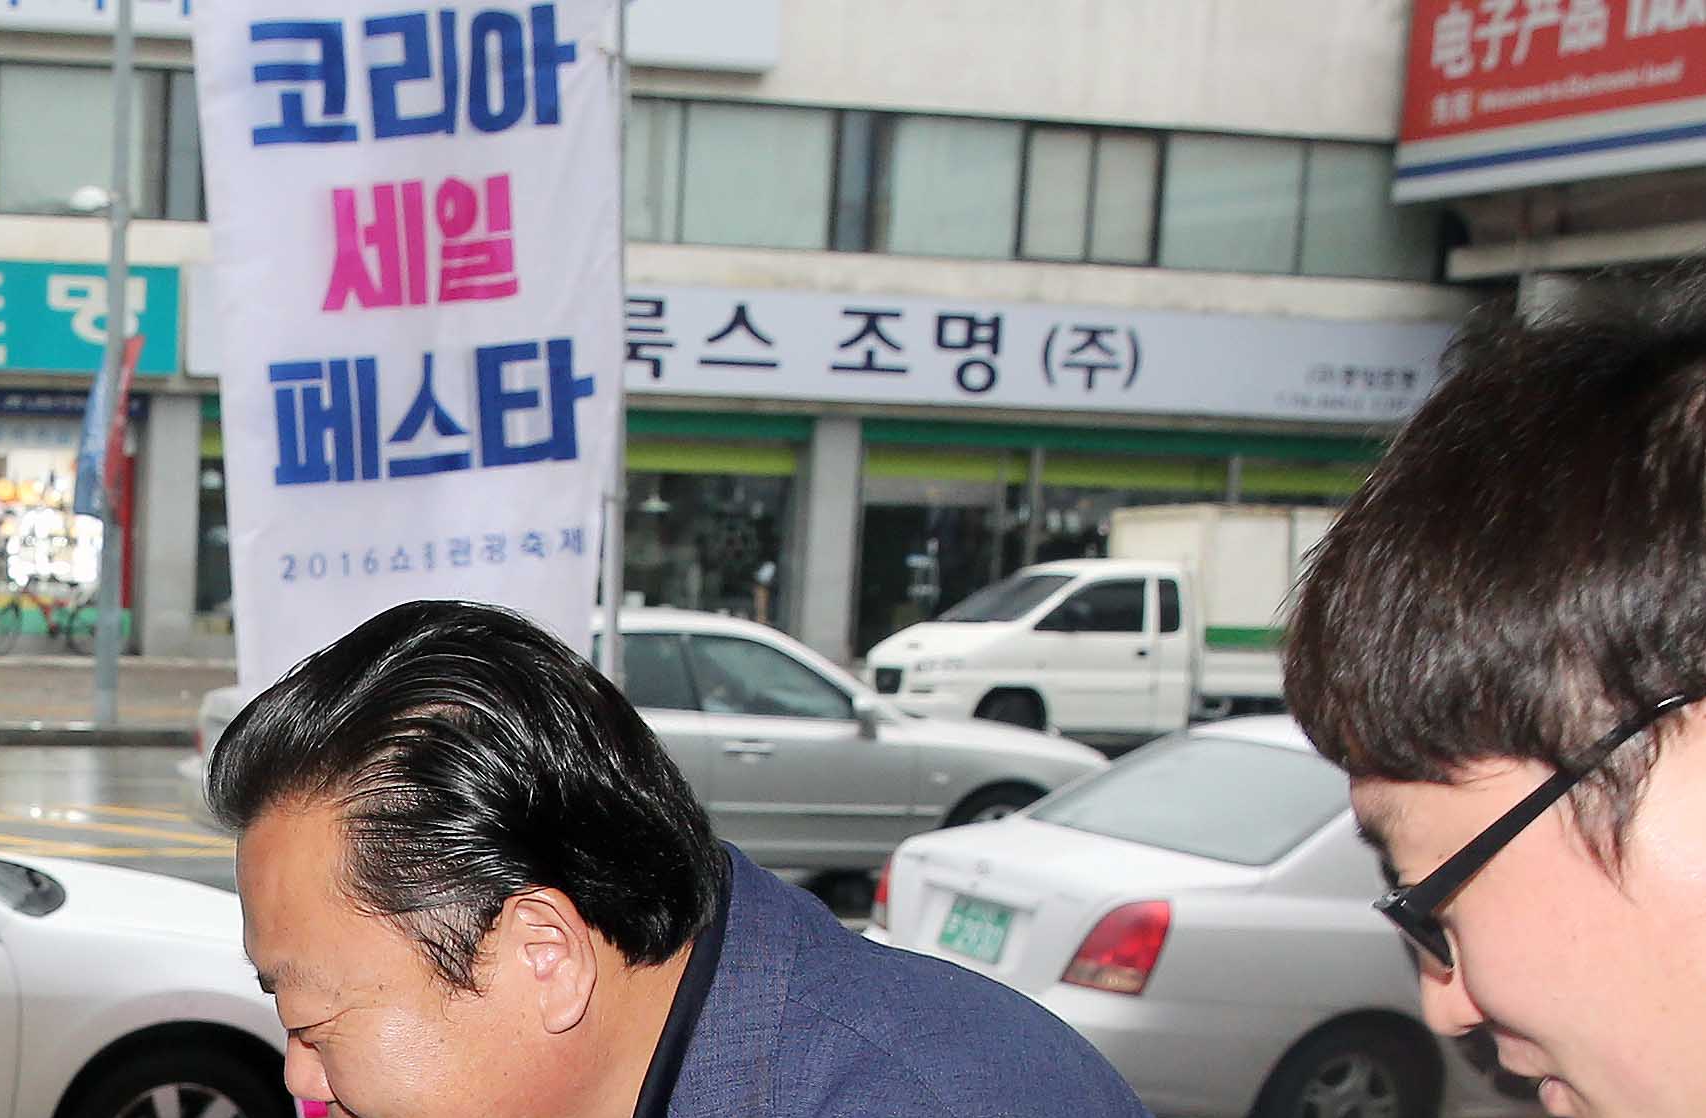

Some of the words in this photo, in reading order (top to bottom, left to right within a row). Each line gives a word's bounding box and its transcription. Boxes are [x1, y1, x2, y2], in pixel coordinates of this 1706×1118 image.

[249, 4, 576, 146] 코리아
[322, 173, 520, 312] 세일
[268, 337, 595, 485] 페스타
[830, 306, 1002, 393] 조명
[1043, 324, 1141, 391] (주)
